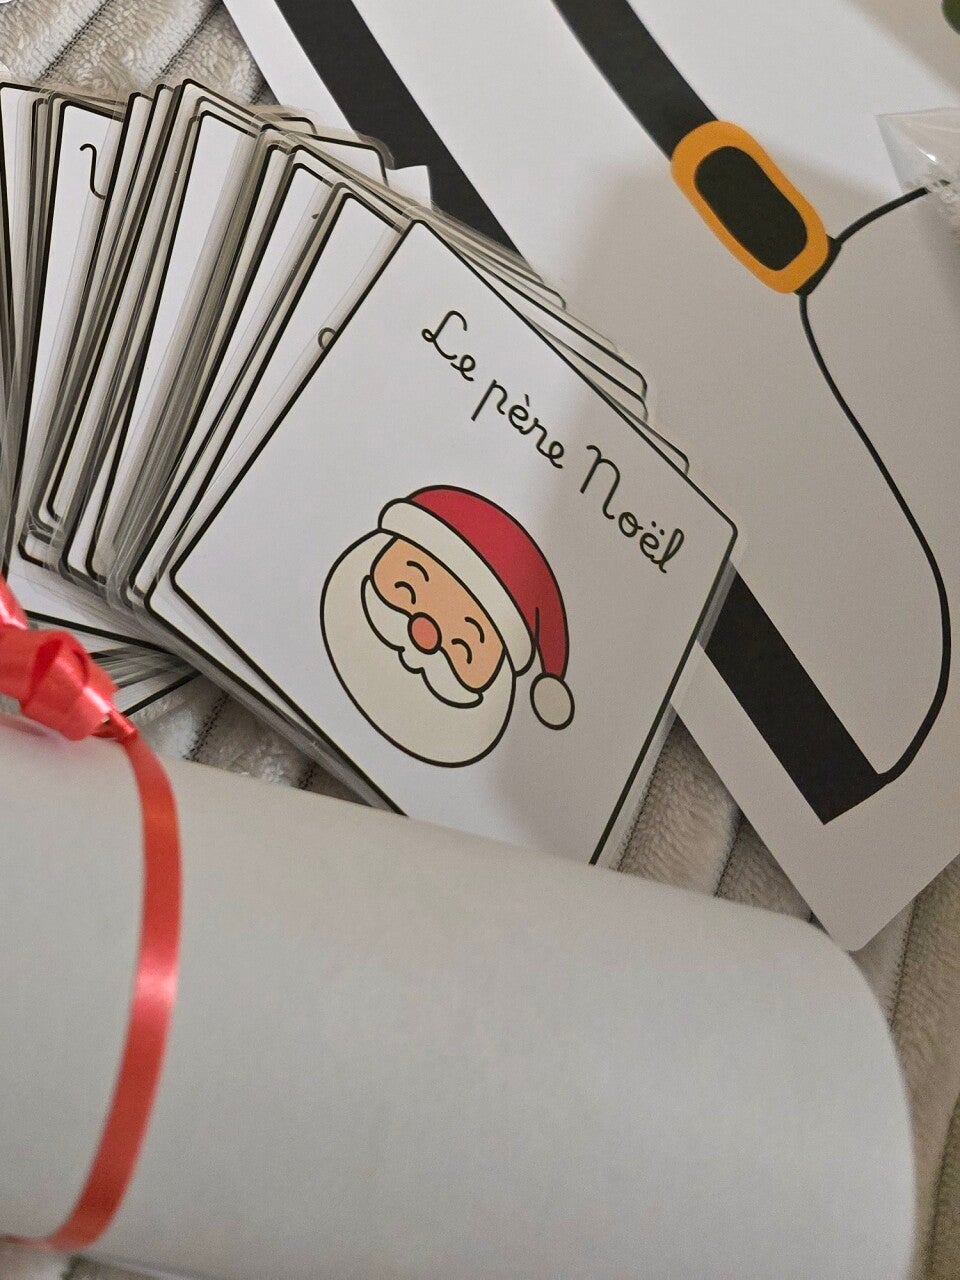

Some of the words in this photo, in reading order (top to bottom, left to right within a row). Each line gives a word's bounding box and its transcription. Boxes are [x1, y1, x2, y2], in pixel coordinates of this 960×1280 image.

[421, 310, 476, 382] Le
[470, 378, 565, 470] père
[578, 443, 685, 574] Noël
